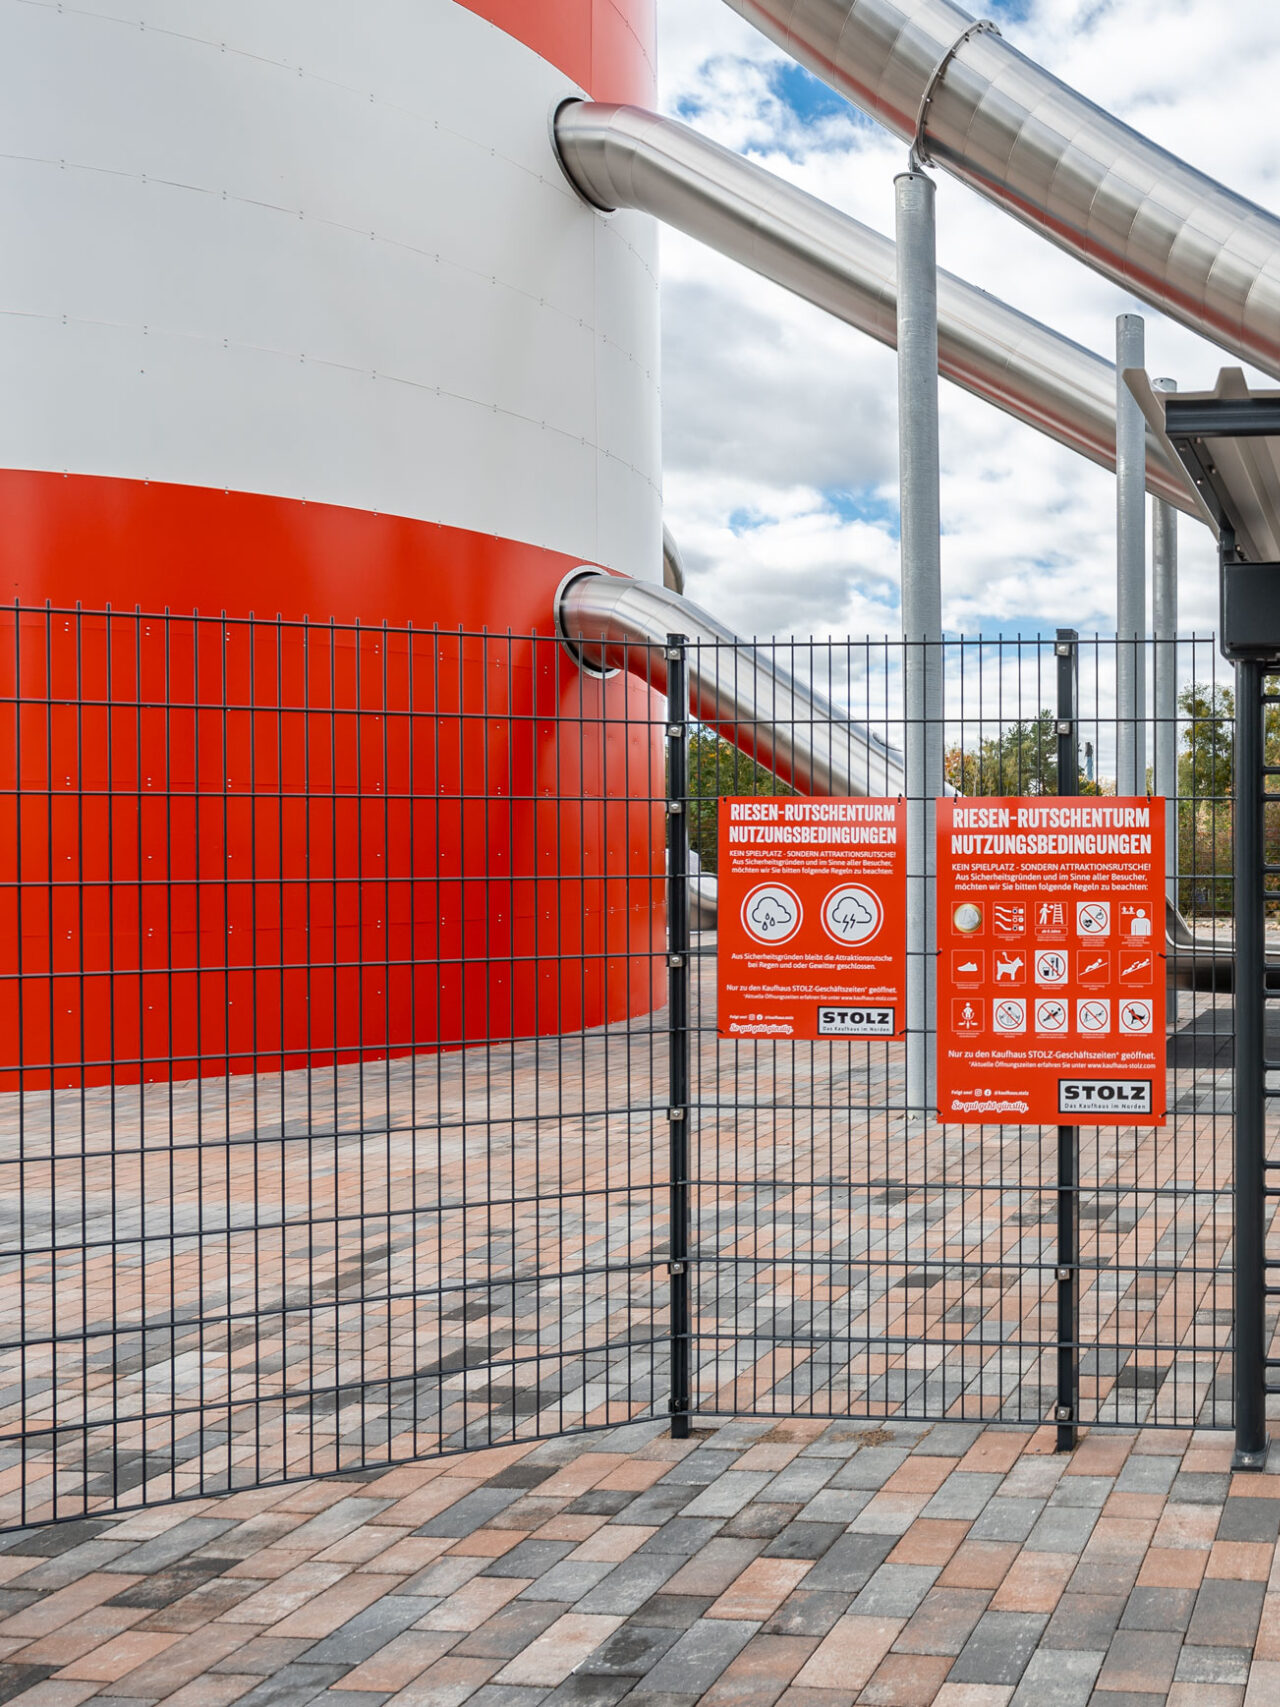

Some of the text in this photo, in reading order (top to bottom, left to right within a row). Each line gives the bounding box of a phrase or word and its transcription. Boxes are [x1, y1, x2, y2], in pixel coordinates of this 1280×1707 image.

[731, 804, 895, 821] RIESEN-RUTSCHENTURM
[953, 808, 1149, 828] RIESEN-RUTSCHENTURM
[729, 826, 896, 844] NUTZUNGSBEDINGUNGEN
[952, 834, 1151, 854] NUTZUNGSBEDINGUNGEN
[971, 873, 1041, 882] Sicherheitsgründen
[1039, 883, 1071, 892] folgende
[1073, 884, 1099, 892] Regeln
[744, 953, 803, 961] Sicherheitsgründen
[823, 1012, 889, 1024] STOLZ
[1121, 1052, 1156, 1061] geöffnet.
[995, 1061, 1036, 1069] Öffnungszeiten
[1064, 1086, 1145, 1099] STOLZ
[952, 1100, 963, 1110] So
[964, 1102, 978, 1113] gut
[978, 1101, 996, 1113] geht
